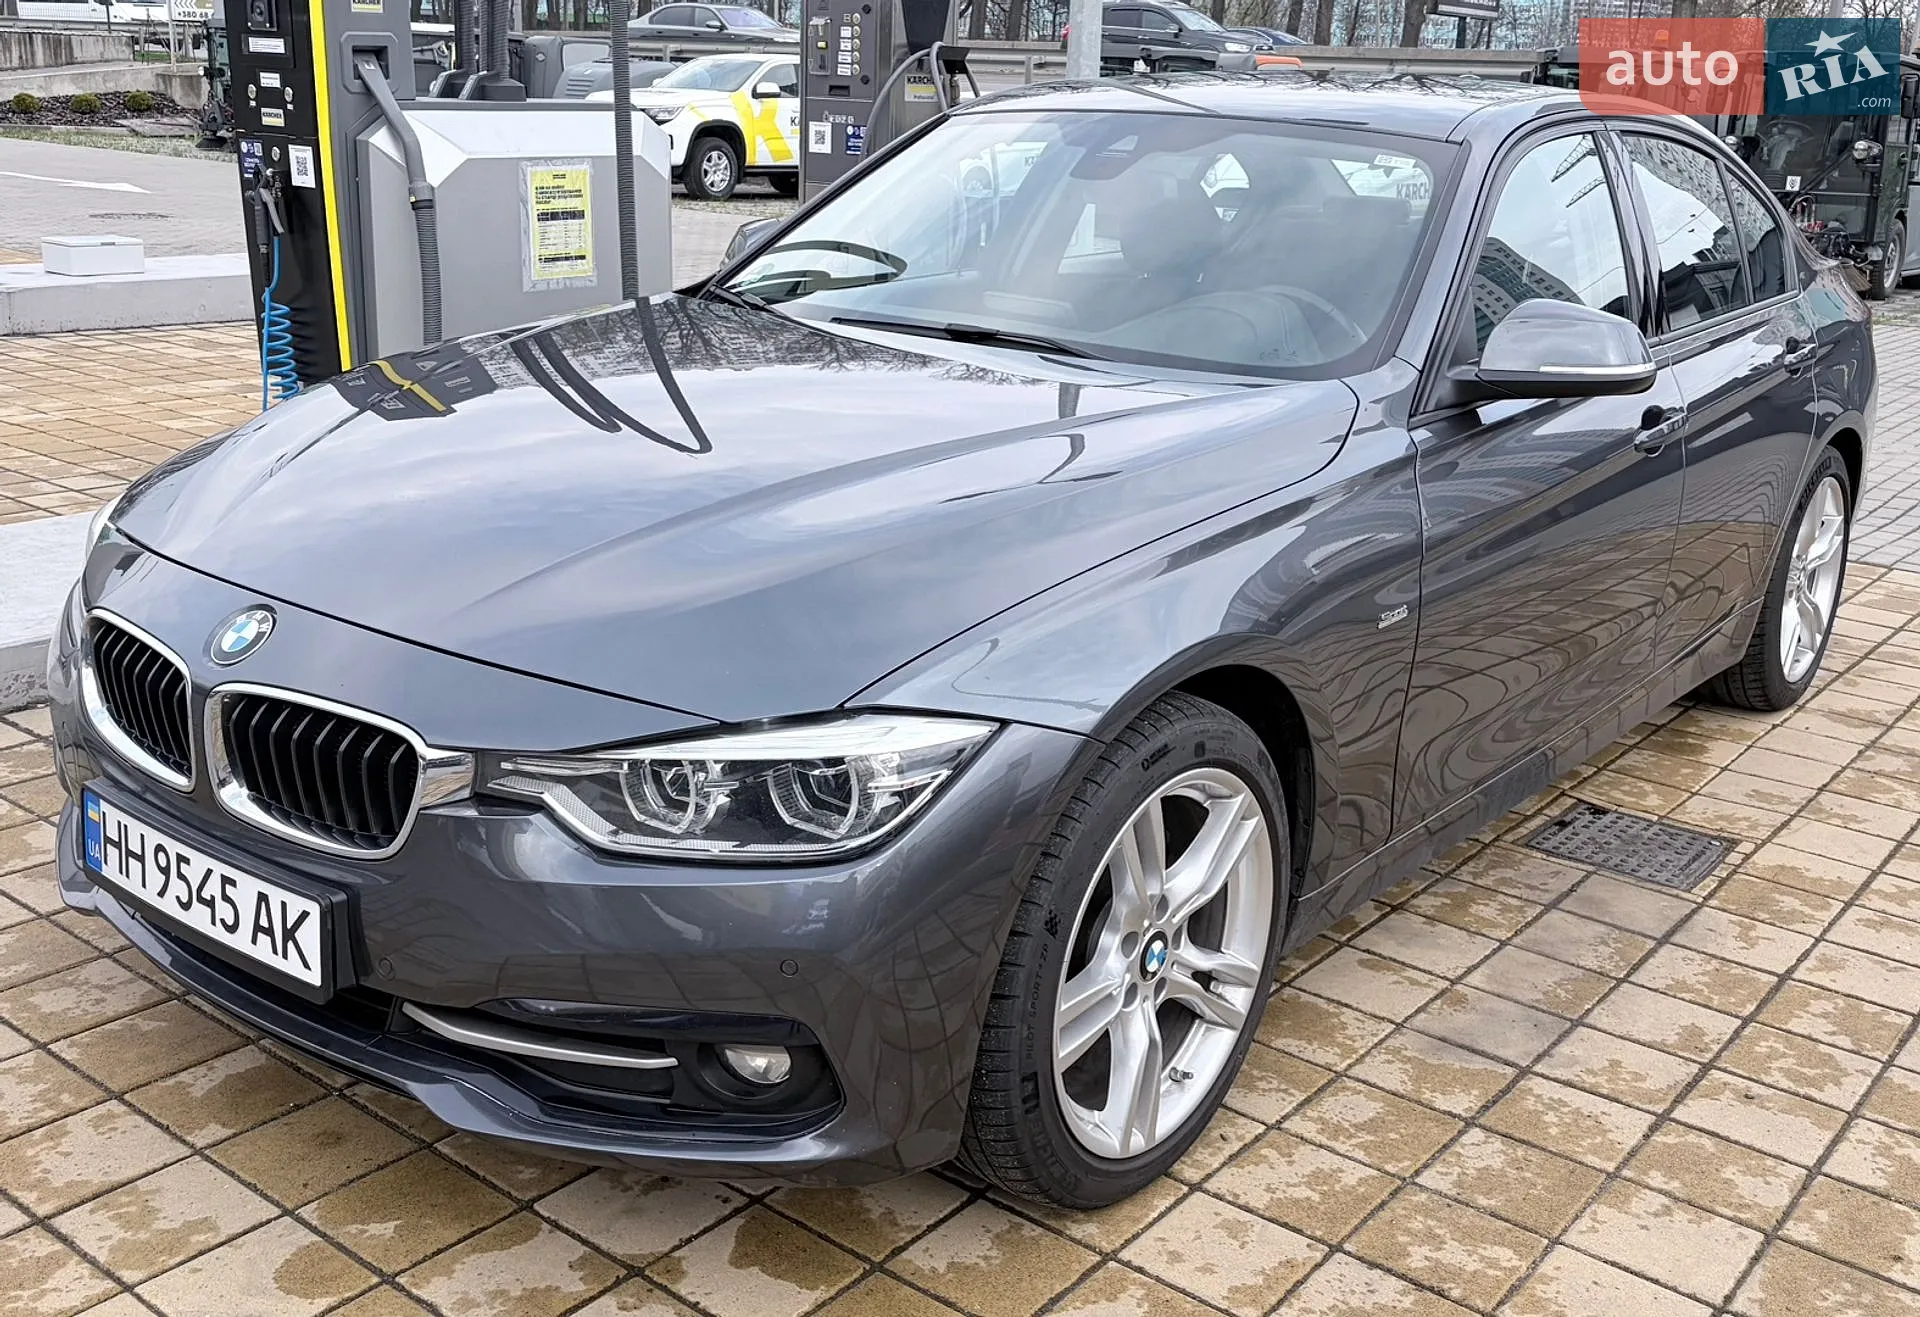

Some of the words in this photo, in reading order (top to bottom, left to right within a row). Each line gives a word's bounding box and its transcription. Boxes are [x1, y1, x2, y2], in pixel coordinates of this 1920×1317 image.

[88, 839, 101, 861] UA
[102, 810, 147, 889] HH
[153, 842, 241, 935] 9545
[251, 890, 312, 972] AK
